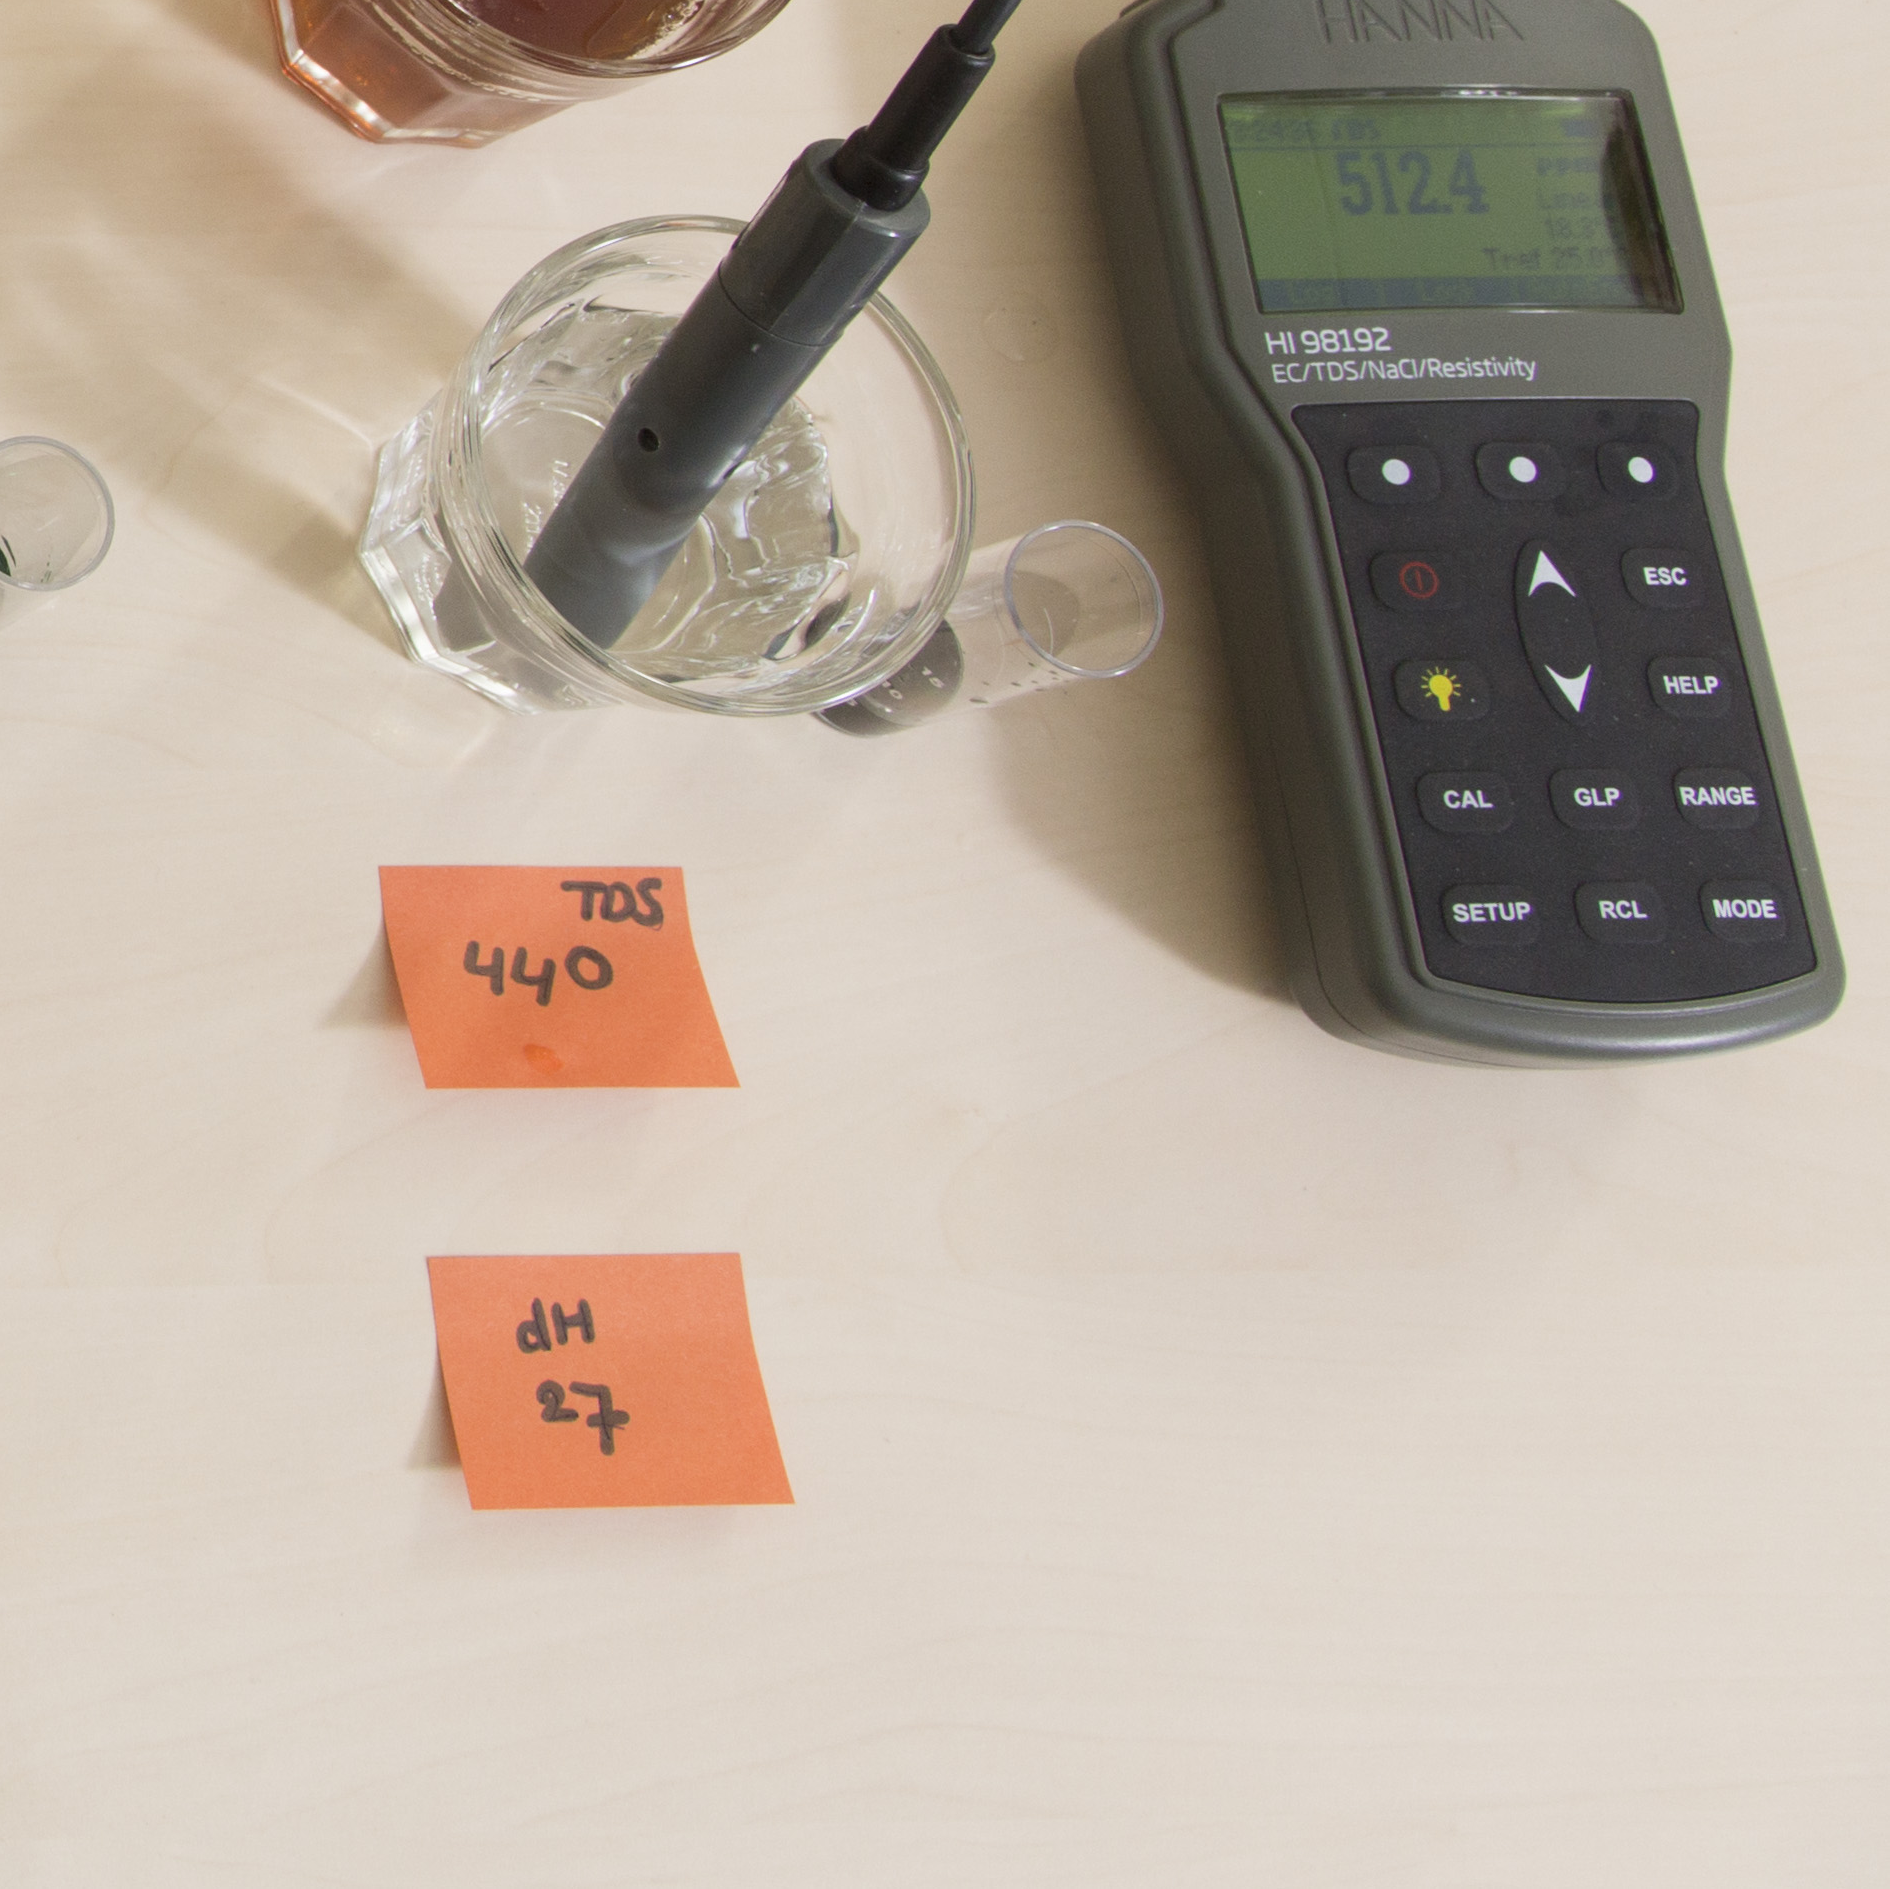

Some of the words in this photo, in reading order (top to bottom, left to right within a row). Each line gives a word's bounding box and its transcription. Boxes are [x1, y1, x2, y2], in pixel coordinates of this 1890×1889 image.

[1336, 148, 1490, 215] 512.4
[1264, 331, 1297, 355] HI
[1300, 326, 1392, 355] 98192
[1271, 356, 1537, 383] EC/TDS/NaCl/Resistivity
[1643, 566, 1687, 586] ESC
[1662, 675, 1719, 695] HELP
[1443, 789, 1494, 809] CAL
[1573, 786, 1621, 807] GLP
[1679, 785, 1757, 807] RANGE
[561, 877, 664, 930] TDS
[1452, 901, 1531, 923] SETUP
[1598, 899, 1648, 919] RCL
[1712, 898, 1778, 919] MODE
[464, 941, 614, 1007] 440
[516, 1298, 595, 1354] dH
[536, 1380, 630, 1456] 27
